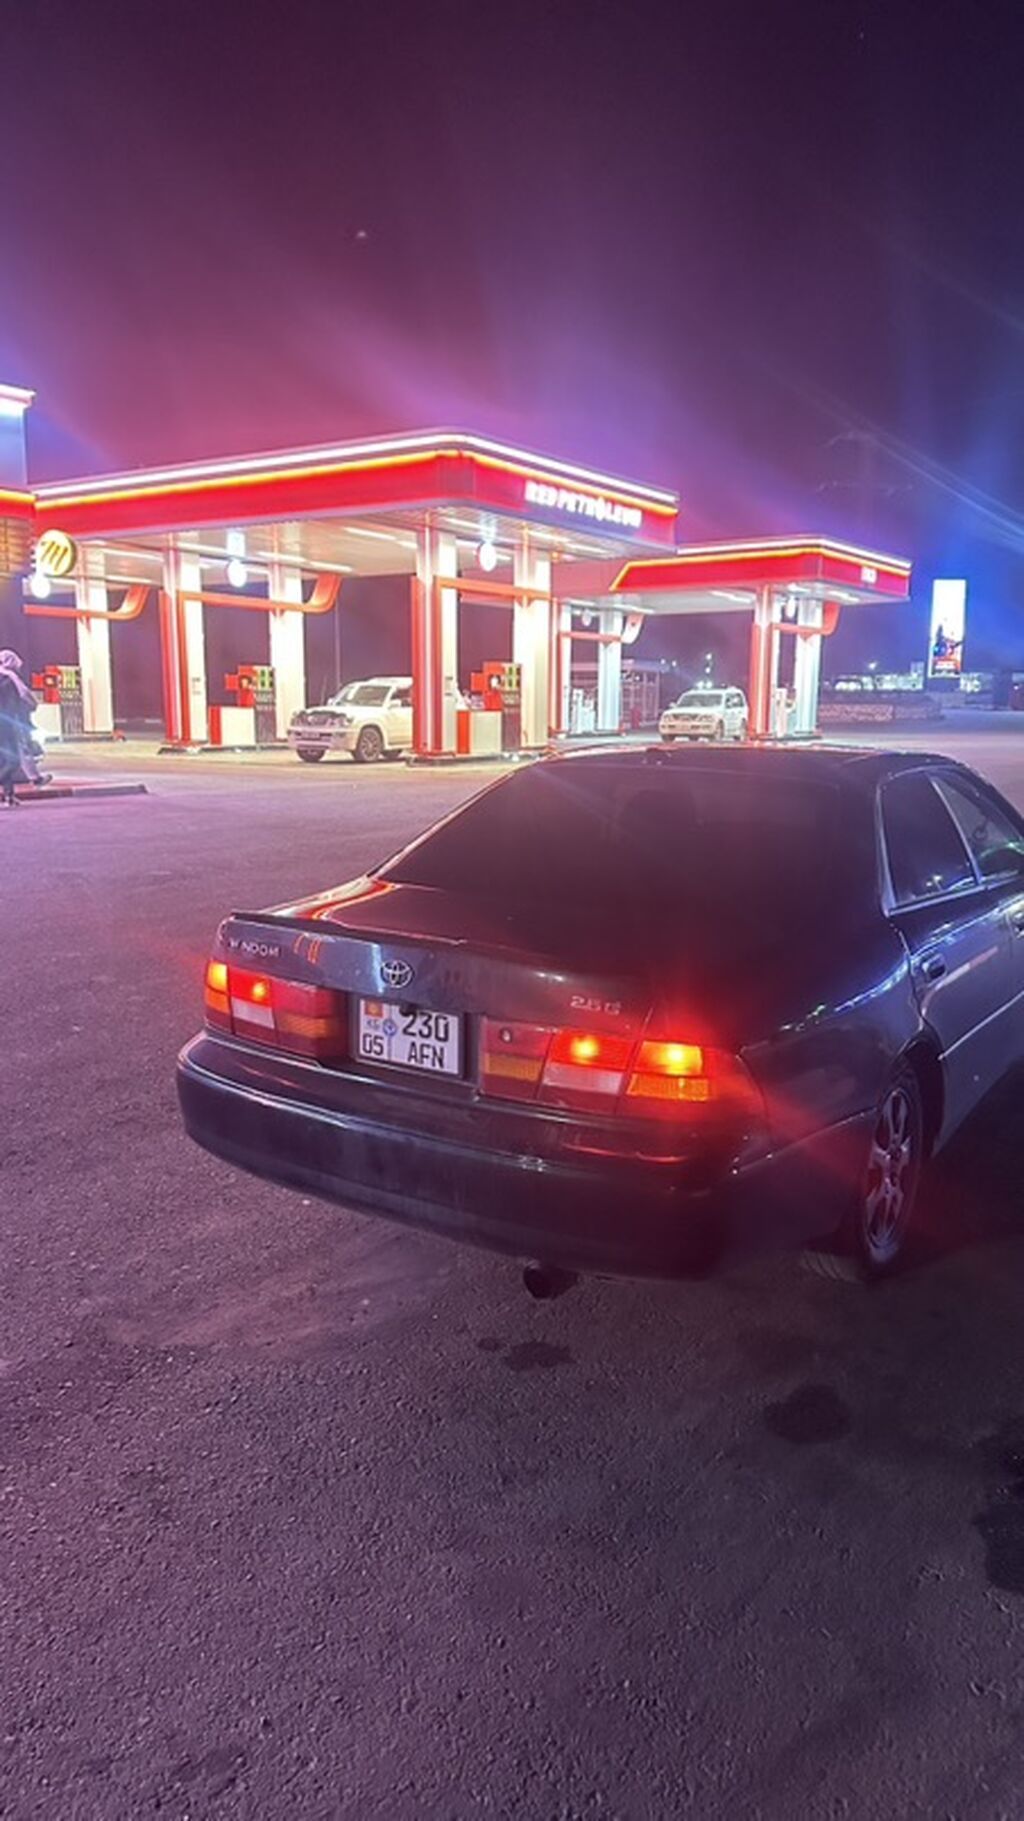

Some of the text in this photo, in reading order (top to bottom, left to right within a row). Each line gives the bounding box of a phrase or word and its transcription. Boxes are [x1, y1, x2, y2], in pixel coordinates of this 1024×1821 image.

[525, 480, 557, 507] RED
[230, 937, 280, 957] WNDOM
[402, 1010, 449, 1043] 230
[362, 1033, 445, 1069] 05 AFN
